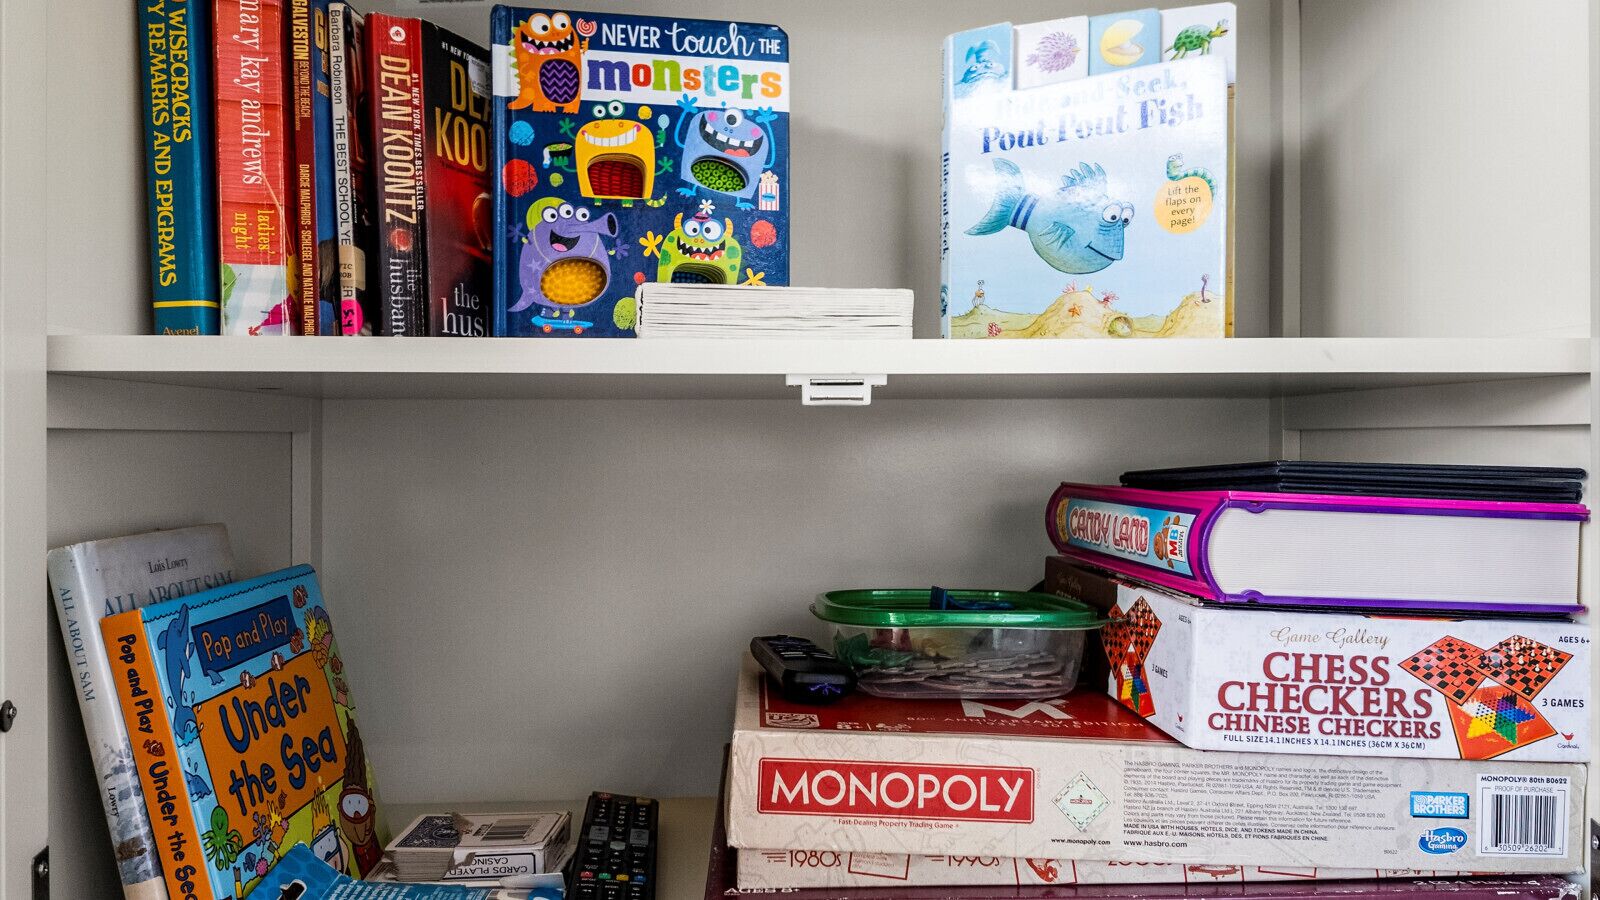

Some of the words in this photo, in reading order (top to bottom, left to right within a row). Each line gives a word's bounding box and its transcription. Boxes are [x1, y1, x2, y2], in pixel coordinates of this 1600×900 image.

[147, 0, 165, 17] Y
[293, 0, 309, 60] GALVESTON
[330, 9, 341, 52] Barbara
[602, 23, 661, 48] NEVER
[665, 22, 755, 57] touch
[759, 39, 781, 55] THE
[450, 45, 462, 58] NEW
[463, 50, 472, 61] YO
[148, 23, 170, 126] REMARKS
[168, 8, 192, 143] WISECRACKS
[233, 54, 269, 94] kay
[299, 61, 310, 85] BEYOND
[332, 55, 343, 104] Robinson
[380, 54, 413, 122] DEAN
[411, 73, 418, 84] #1
[587, 59, 782, 99] monsters
[300, 86, 310, 97] THE
[412, 87, 420, 105] NEW
[450, 60, 490, 122] DE
[301, 98, 311, 118] BEACH
[413, 108, 421, 130] YORK
[1137, 93, 1204, 130] Fish
[241, 98, 271, 185] andrews
[335, 115, 345, 139] THE
[435, 106, 487, 172] KOO
[153, 131, 172, 175] AND
[336, 143, 347, 173] BEST
[414, 132, 422, 158] TIMES
[299, 164, 310, 188] DARCIE
[382, 127, 417, 224] KOONTZ
[415, 160, 424, 211] BESTSELLER
[1167, 185, 1183, 196] Lift
[1184, 184, 1200, 194] the
[300, 188, 311, 225] MALPHRUS
[338, 178, 350, 227] SCHOOL
[1165, 196, 1187, 206] flaps
[1190, 195, 1201, 204] on
[1171, 207, 1195, 217] every
[155, 179, 177, 287] EPIGRAMS
[231, 212, 253, 250] night
[1170, 215, 1196, 227] page!
[301, 230, 312, 262] SCHLEGEL
[340, 230, 351, 245] YE
[302, 262, 313, 277] AND
[303, 277, 314, 304] NATALIE
[389, 258, 412, 337] husban
[454, 282, 480, 310] the
[163, 325, 200, 336] Avenel
[441, 297, 490, 337] hus
[1068, 507, 1111, 548] CANDY
[1112, 514, 1149, 556] LAND
[1168, 526, 1179, 558] MB
[147, 560, 166, 574] Lois
[166, 557, 189, 571] Lowry
[149, 577, 201, 606] ABOUT
[203, 570, 235, 589] SAM
[59, 587, 74, 616] ALL
[67, 619, 89, 665] ABOUT
[79, 667, 95, 702] SAM
[117, 633, 136, 665] Pop
[201, 630, 232, 662] Pop
[235, 624, 260, 649] and
[258, 612, 288, 642] Play
[1269, 626, 1320, 645] Game
[1326, 627, 1392, 649] Gallery
[1558, 636, 1579, 644] AGES
[127, 667, 149, 698] and
[1155, 665, 1168, 679] GAMES
[1262, 651, 1391, 686] CHESS
[218, 674, 311, 753] Under
[1216, 680, 1432, 719] CHECKERS
[1542, 698, 1548, 707] 3
[1551, 699, 1585, 708] GAMES
[134, 698, 154, 734] Play
[1207, 712, 1312, 734] CHINESE
[1317, 715, 1442, 740] CHECKERS
[1223, 734, 1244, 742] FULL
[1246, 735, 1264, 743] SIZE
[1265, 736, 1280, 744] 14.1
[1281, 737, 1311, 745] INCHES
[1320, 738, 1336, 746] 14.1
[1337, 739, 1366, 747] INCHES
[1368, 740, 1392, 748] (36CM
[1401, 741, 1426, 750] 36CM)
[229, 759, 277, 817] the
[280, 725, 338, 791] Sea
[1546, 777, 1568, 785] B0622
[107, 787, 119, 818] Lowry
[148, 760, 179, 827] Under
[770, 768, 1025, 813] MONOPOLY
[1429, 795, 1465, 805] PARKER
[838, 818, 877, 828] Fast-Dealing
[878, 820, 908, 828] Property
[909, 821, 933, 829] Trading
[1414, 804, 1465, 815] BROTHERS
[167, 831, 187, 862] the
[1050, 838, 1111, 846] www.monopoly.com
[1123, 840, 1188, 848] www.hasbro.com
[1421, 830, 1464, 844] Hasbro
[1428, 842, 1458, 851] Gaming
[449, 867, 489, 875] PLAYED
[492, 865, 528, 874] CARDS
[789, 850, 842, 868] 1980s
[948, 855, 1000, 867] 1990s
